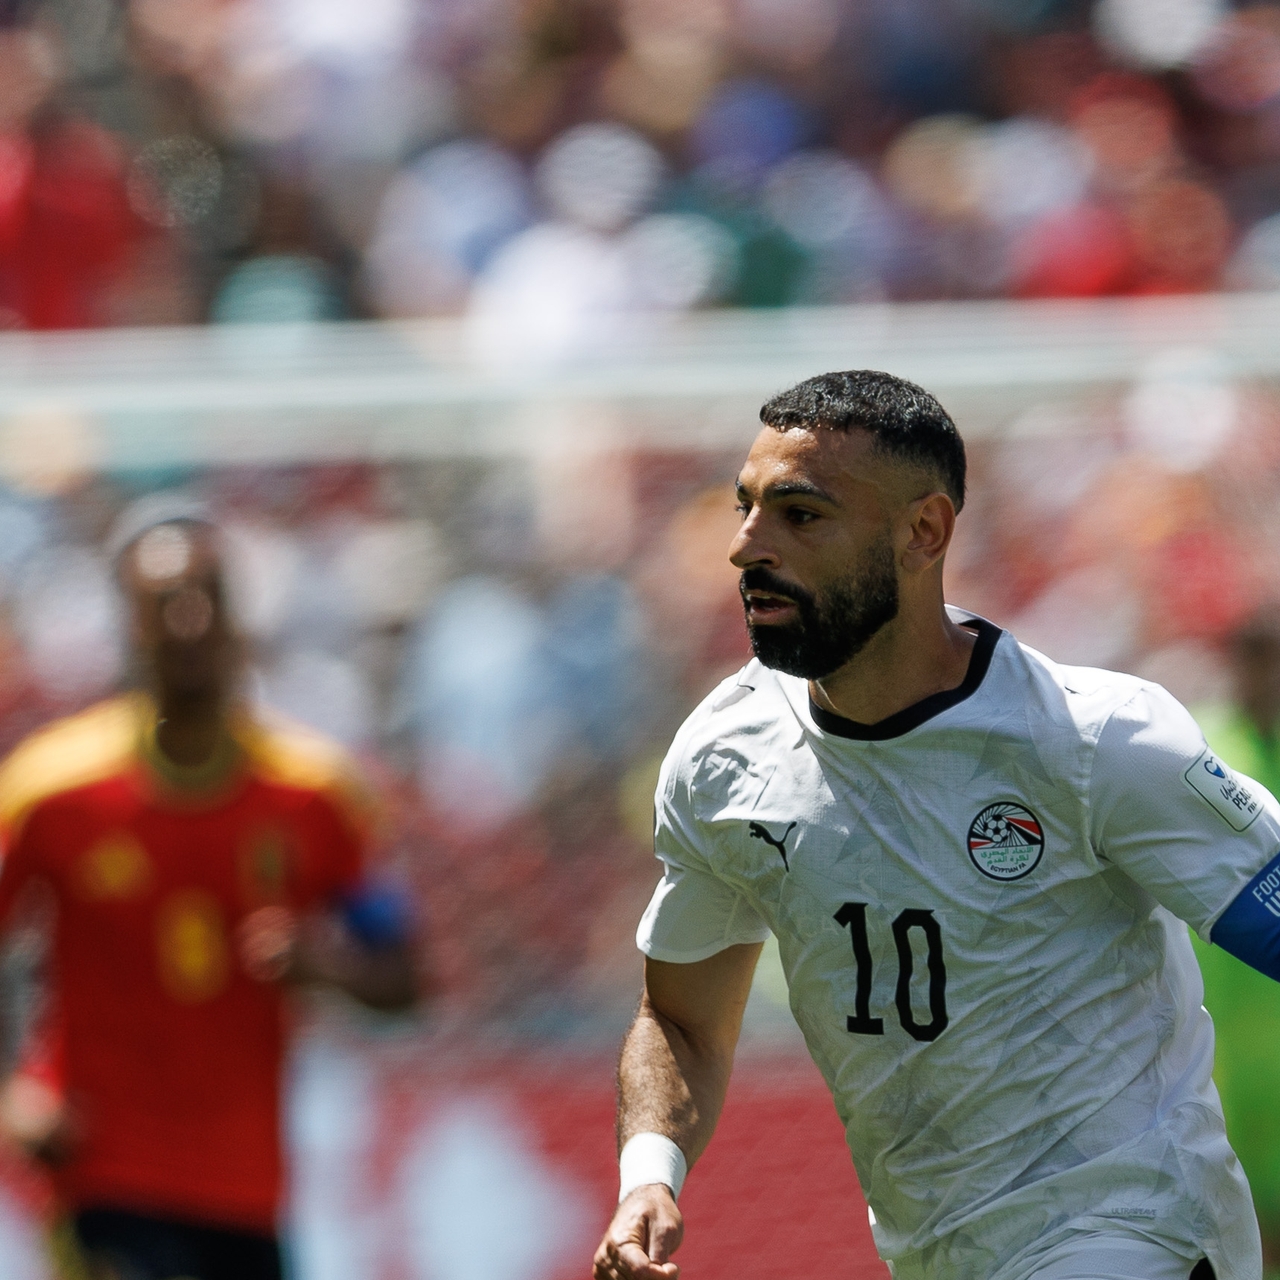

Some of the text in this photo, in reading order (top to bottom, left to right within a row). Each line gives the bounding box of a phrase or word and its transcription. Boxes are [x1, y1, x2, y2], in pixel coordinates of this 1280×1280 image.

[990, 862, 1027, 874] EGYPTIAN FA
[833, 902, 949, 1042] 10
